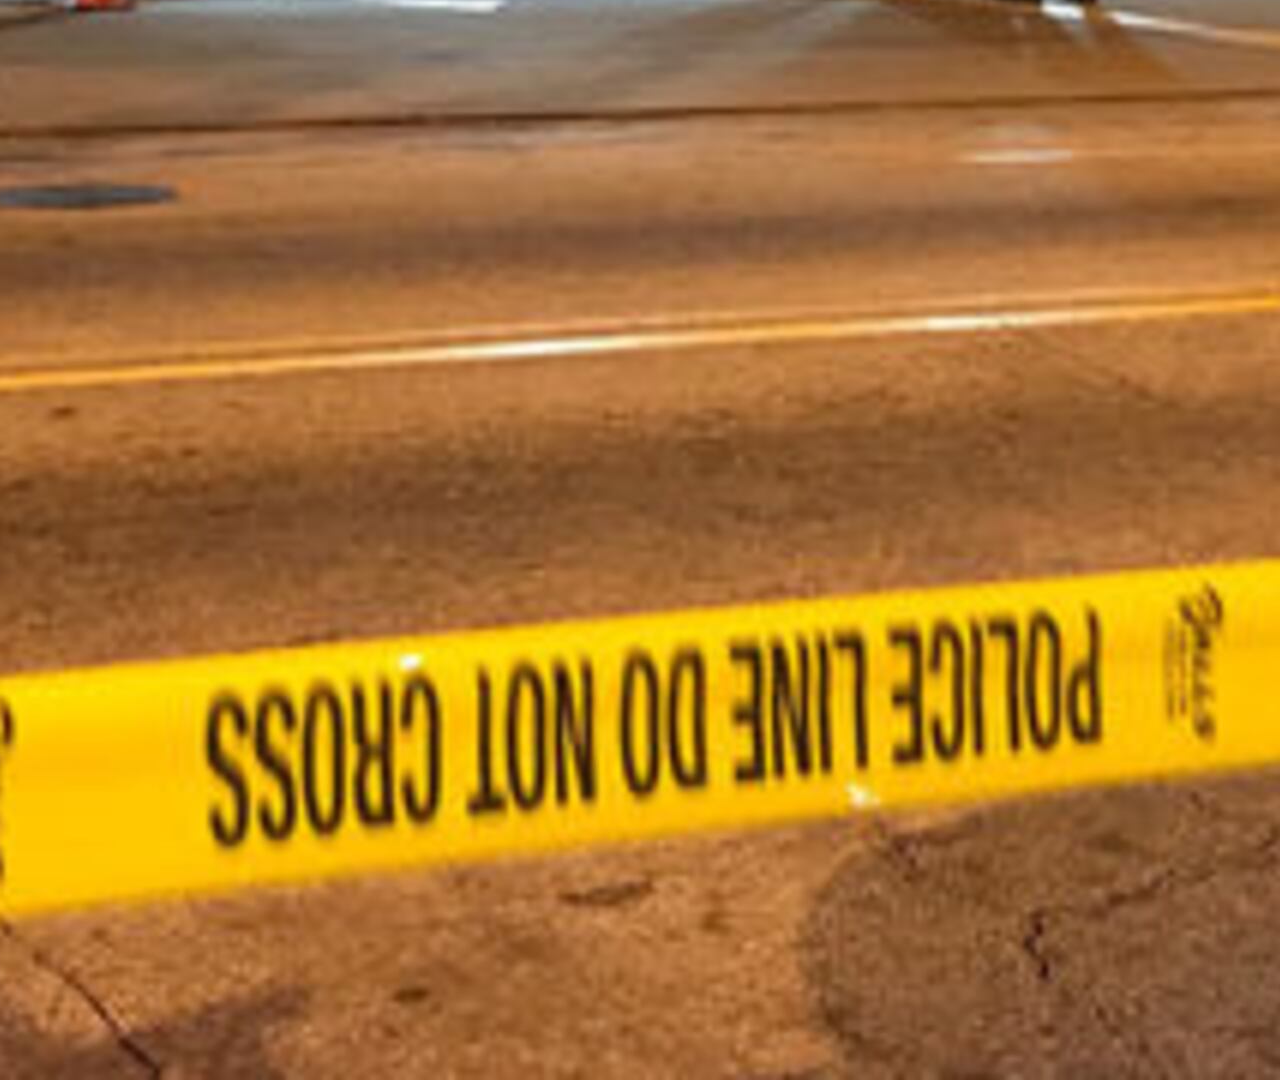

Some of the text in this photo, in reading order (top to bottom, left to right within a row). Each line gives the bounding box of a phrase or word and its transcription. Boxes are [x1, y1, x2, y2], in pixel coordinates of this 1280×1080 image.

[203, 671, 444, 851] CROSS
[465, 657, 599, 820] NOT
[618, 645, 710, 801] DO
[727, 628, 870, 786] LINE
[886, 607, 1105, 768] POLICE
